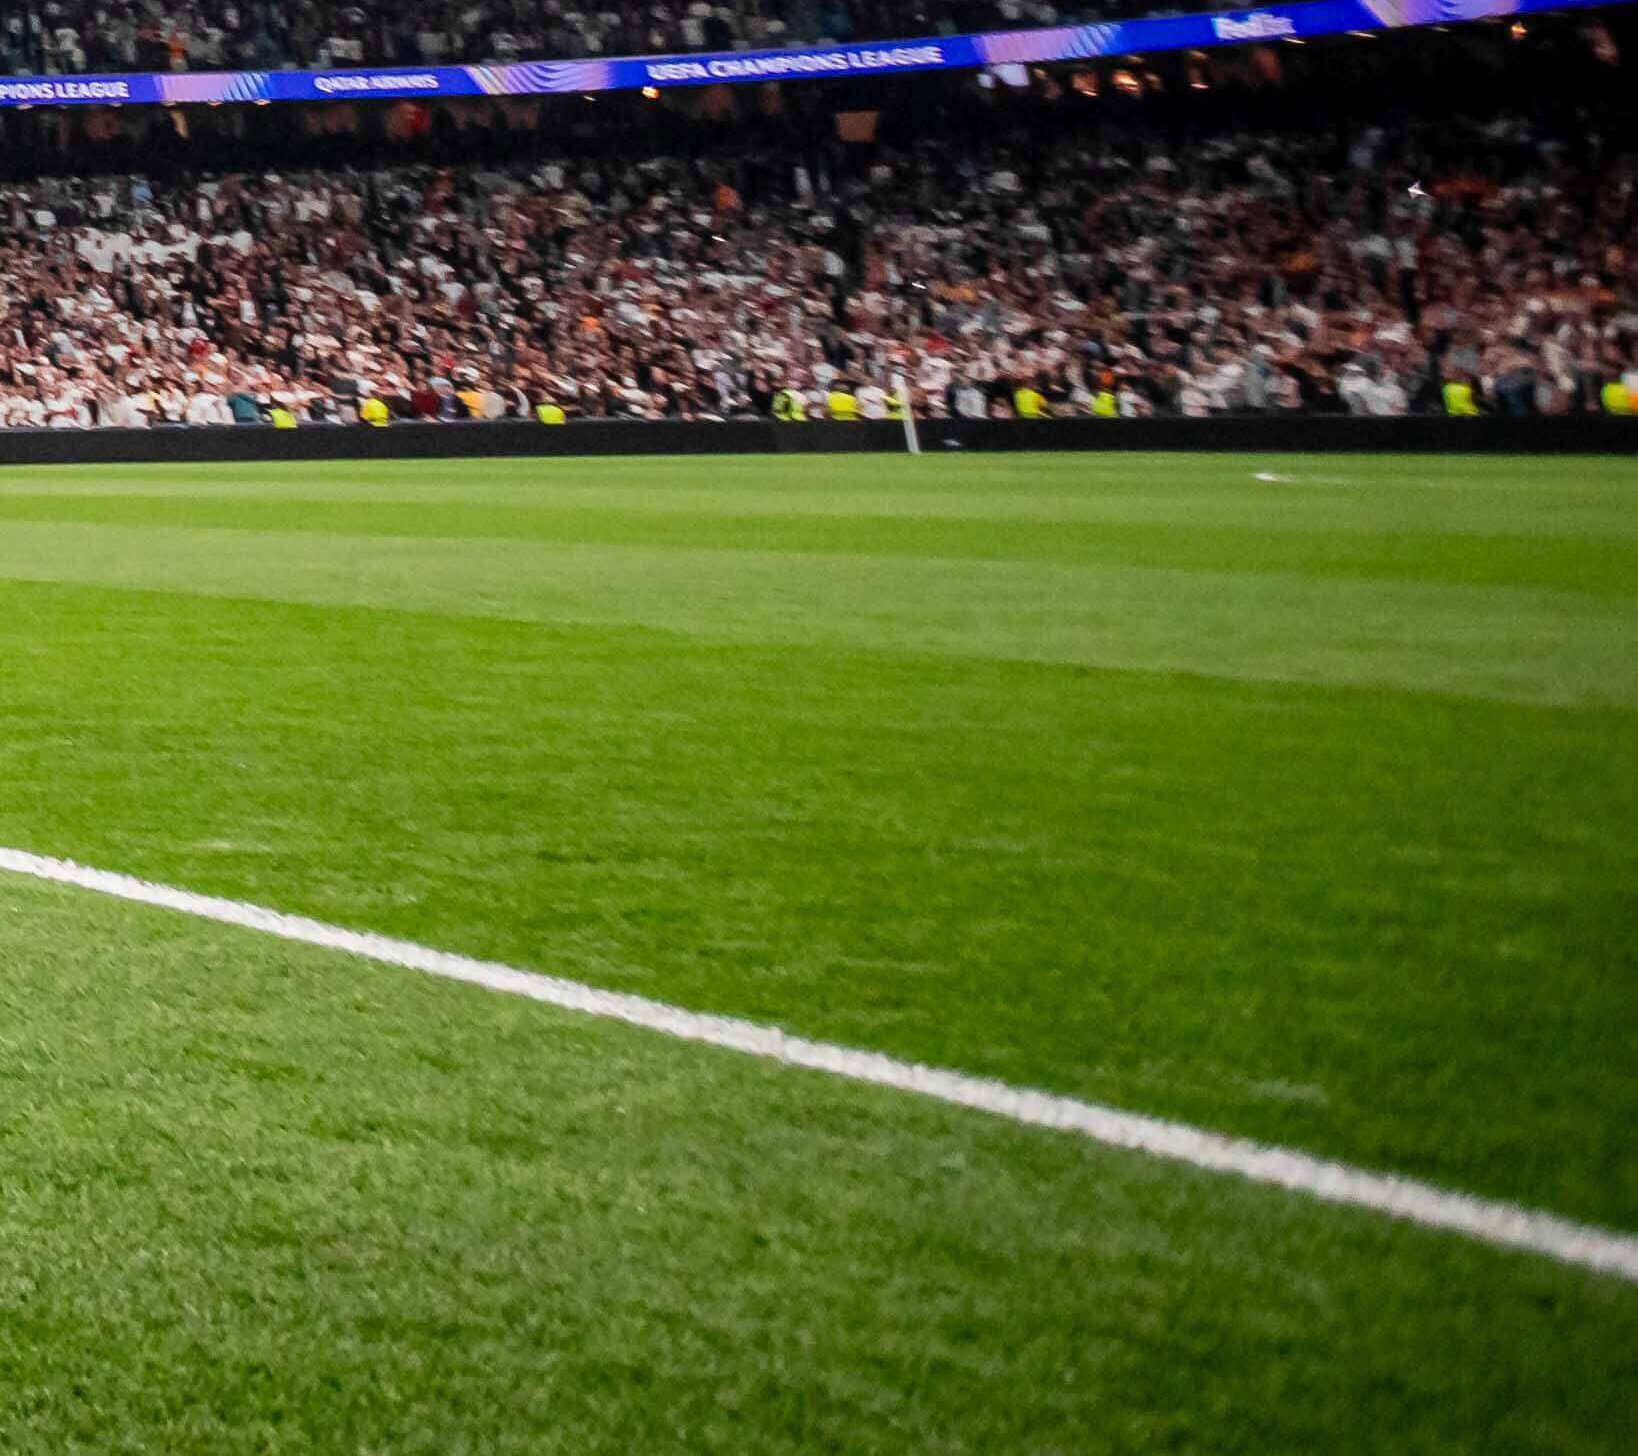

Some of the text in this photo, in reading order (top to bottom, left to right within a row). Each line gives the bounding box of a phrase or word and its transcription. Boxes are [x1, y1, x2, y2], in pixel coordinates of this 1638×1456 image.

[708, 53, 849, 78] CHAMPIONS
[848, 46, 945, 68] LEAGUE
[54, 81, 130, 99] LEAGUE
